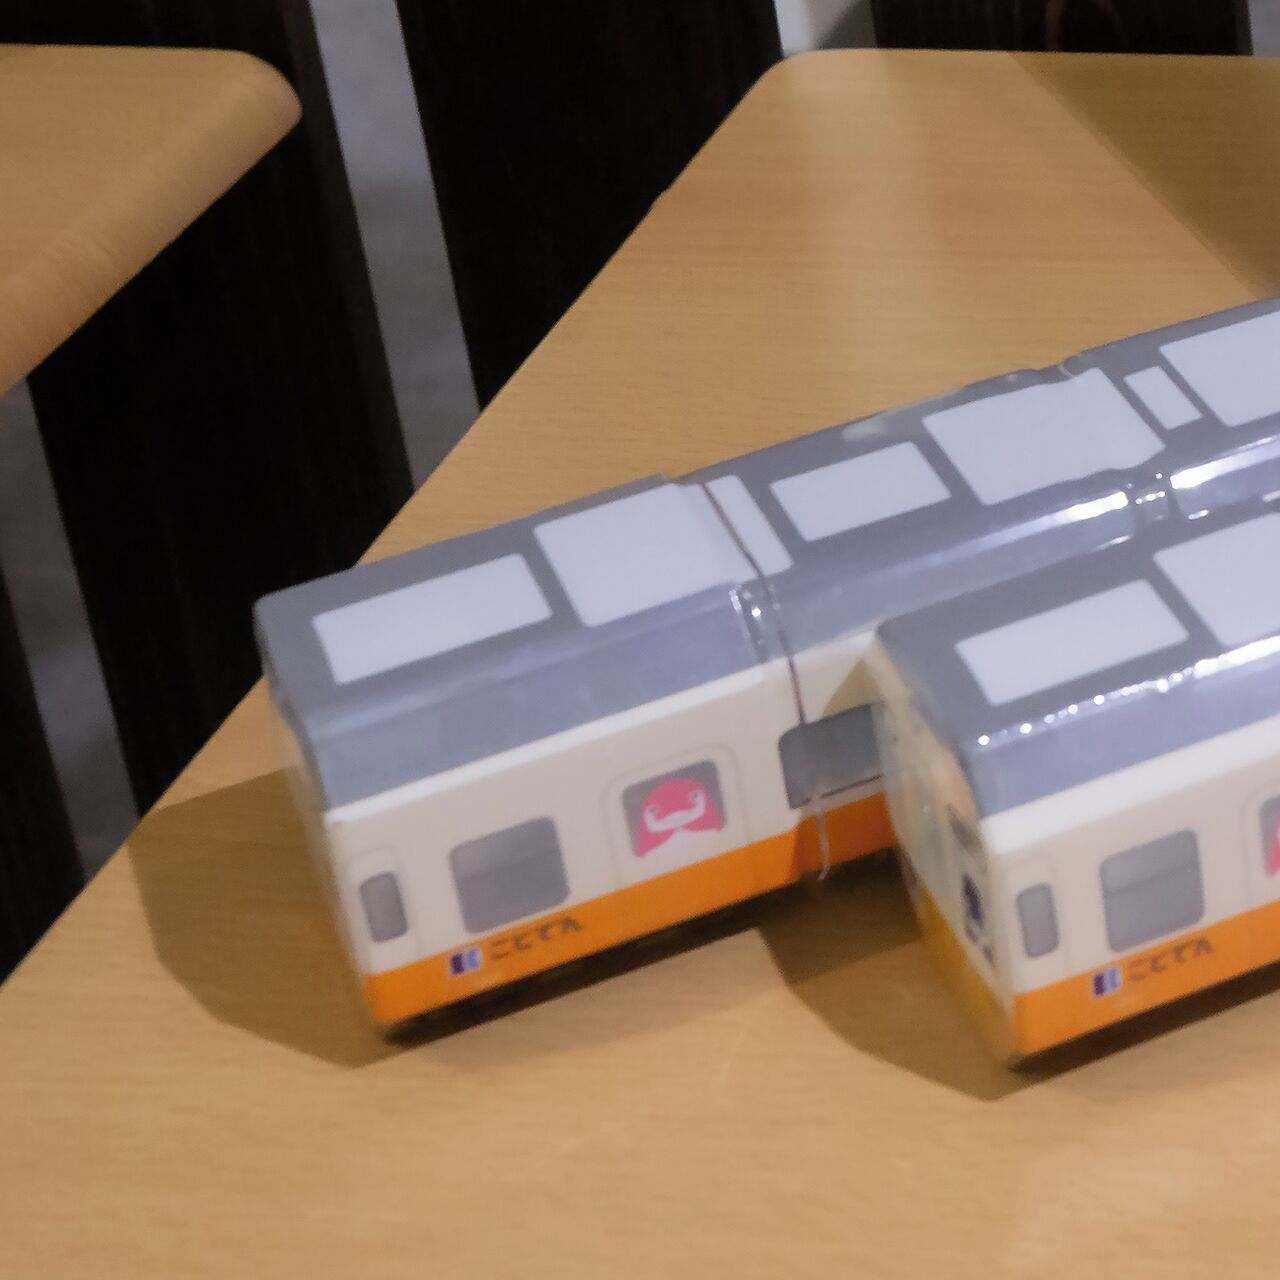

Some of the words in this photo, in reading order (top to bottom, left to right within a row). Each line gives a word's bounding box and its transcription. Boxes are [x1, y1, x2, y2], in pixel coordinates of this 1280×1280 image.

[491, 915, 583, 961] ことでん
[1128, 936, 1215, 982] ことでん
